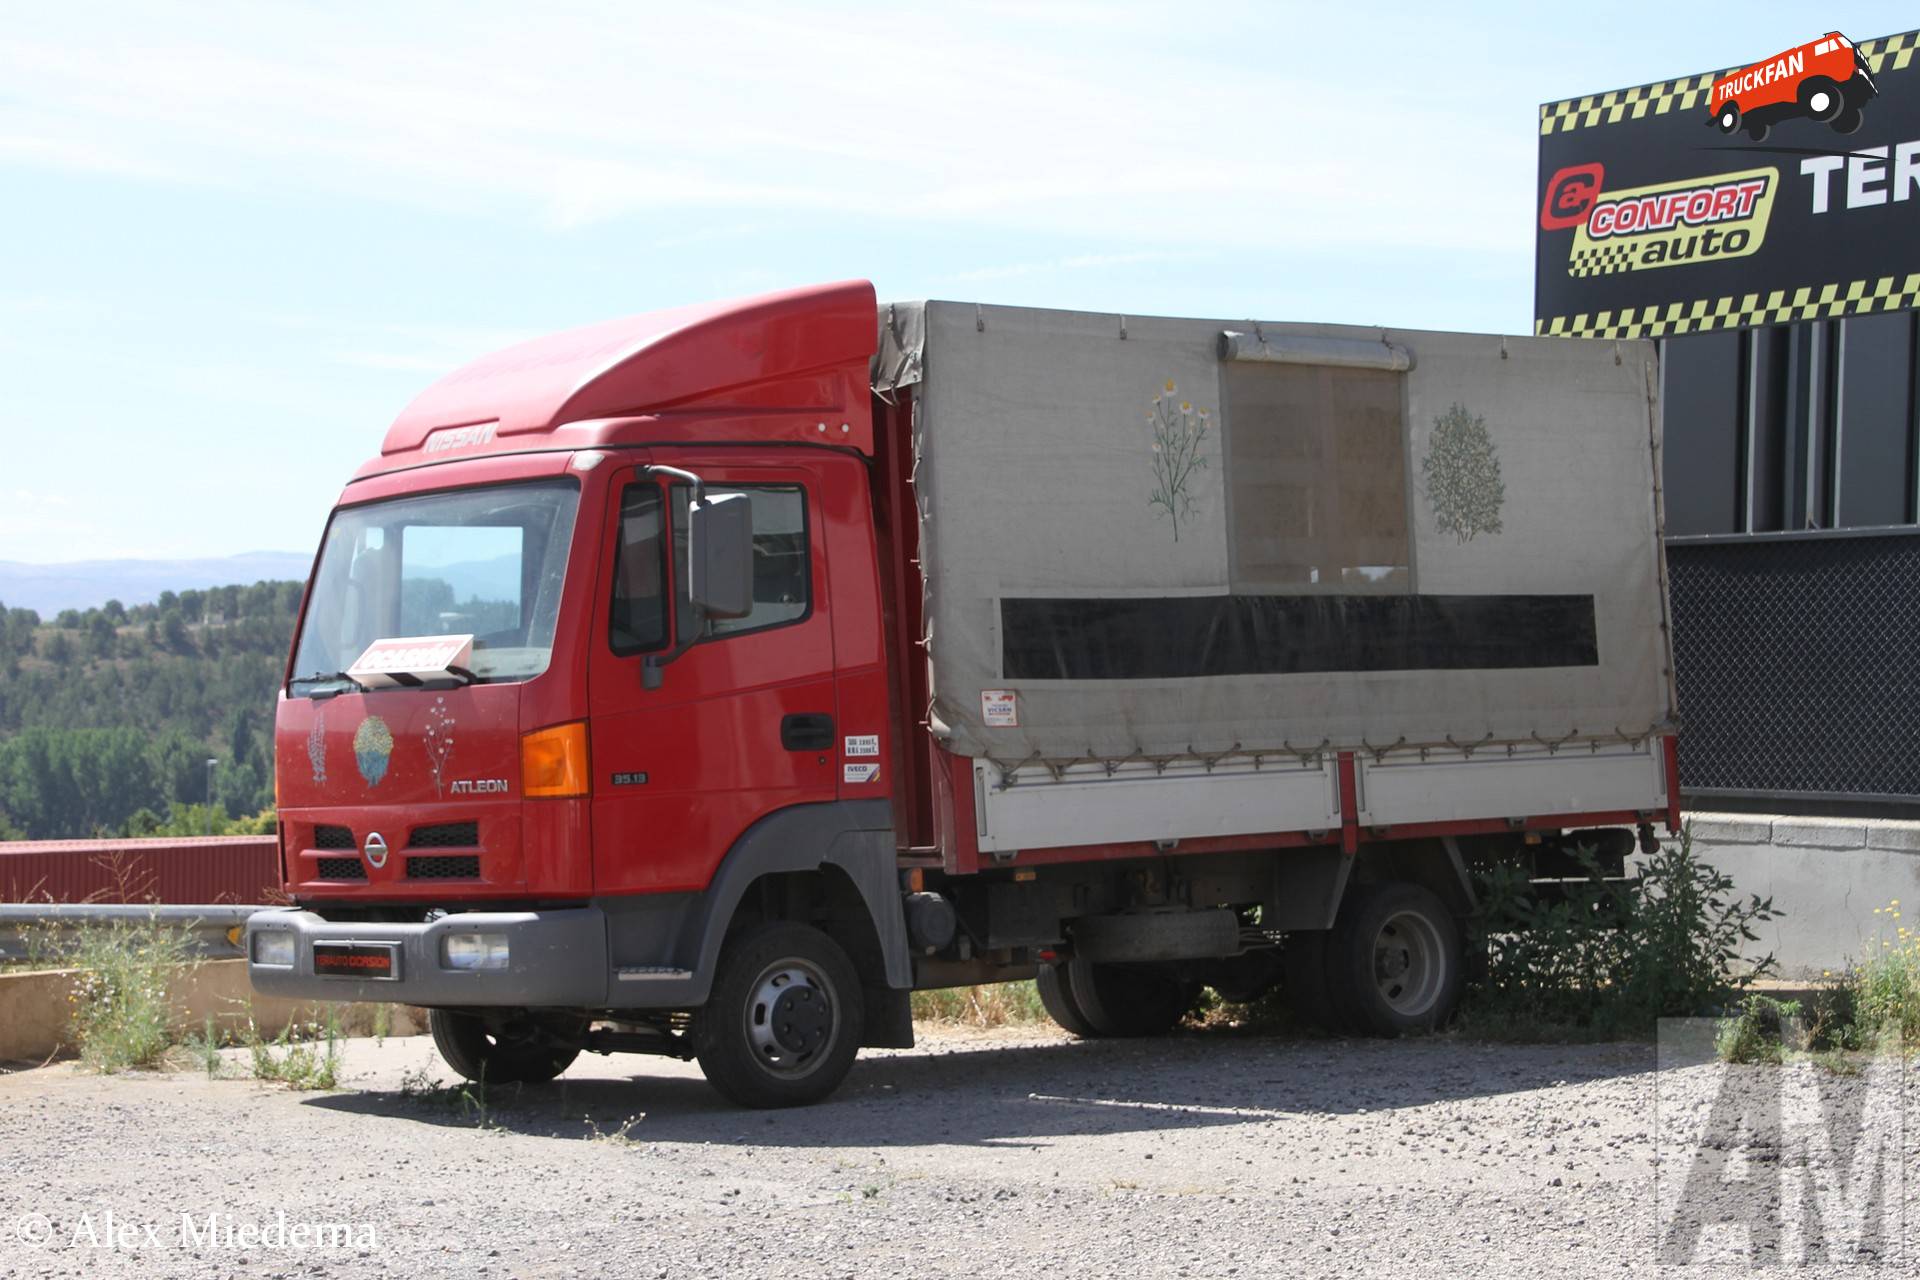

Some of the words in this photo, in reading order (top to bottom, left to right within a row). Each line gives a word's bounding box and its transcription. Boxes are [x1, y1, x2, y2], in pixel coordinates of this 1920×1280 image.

[1589, 180, 1764, 237] CONFORT
[1641, 228, 1750, 265] auto
[450, 779, 508, 794] ATLEON
